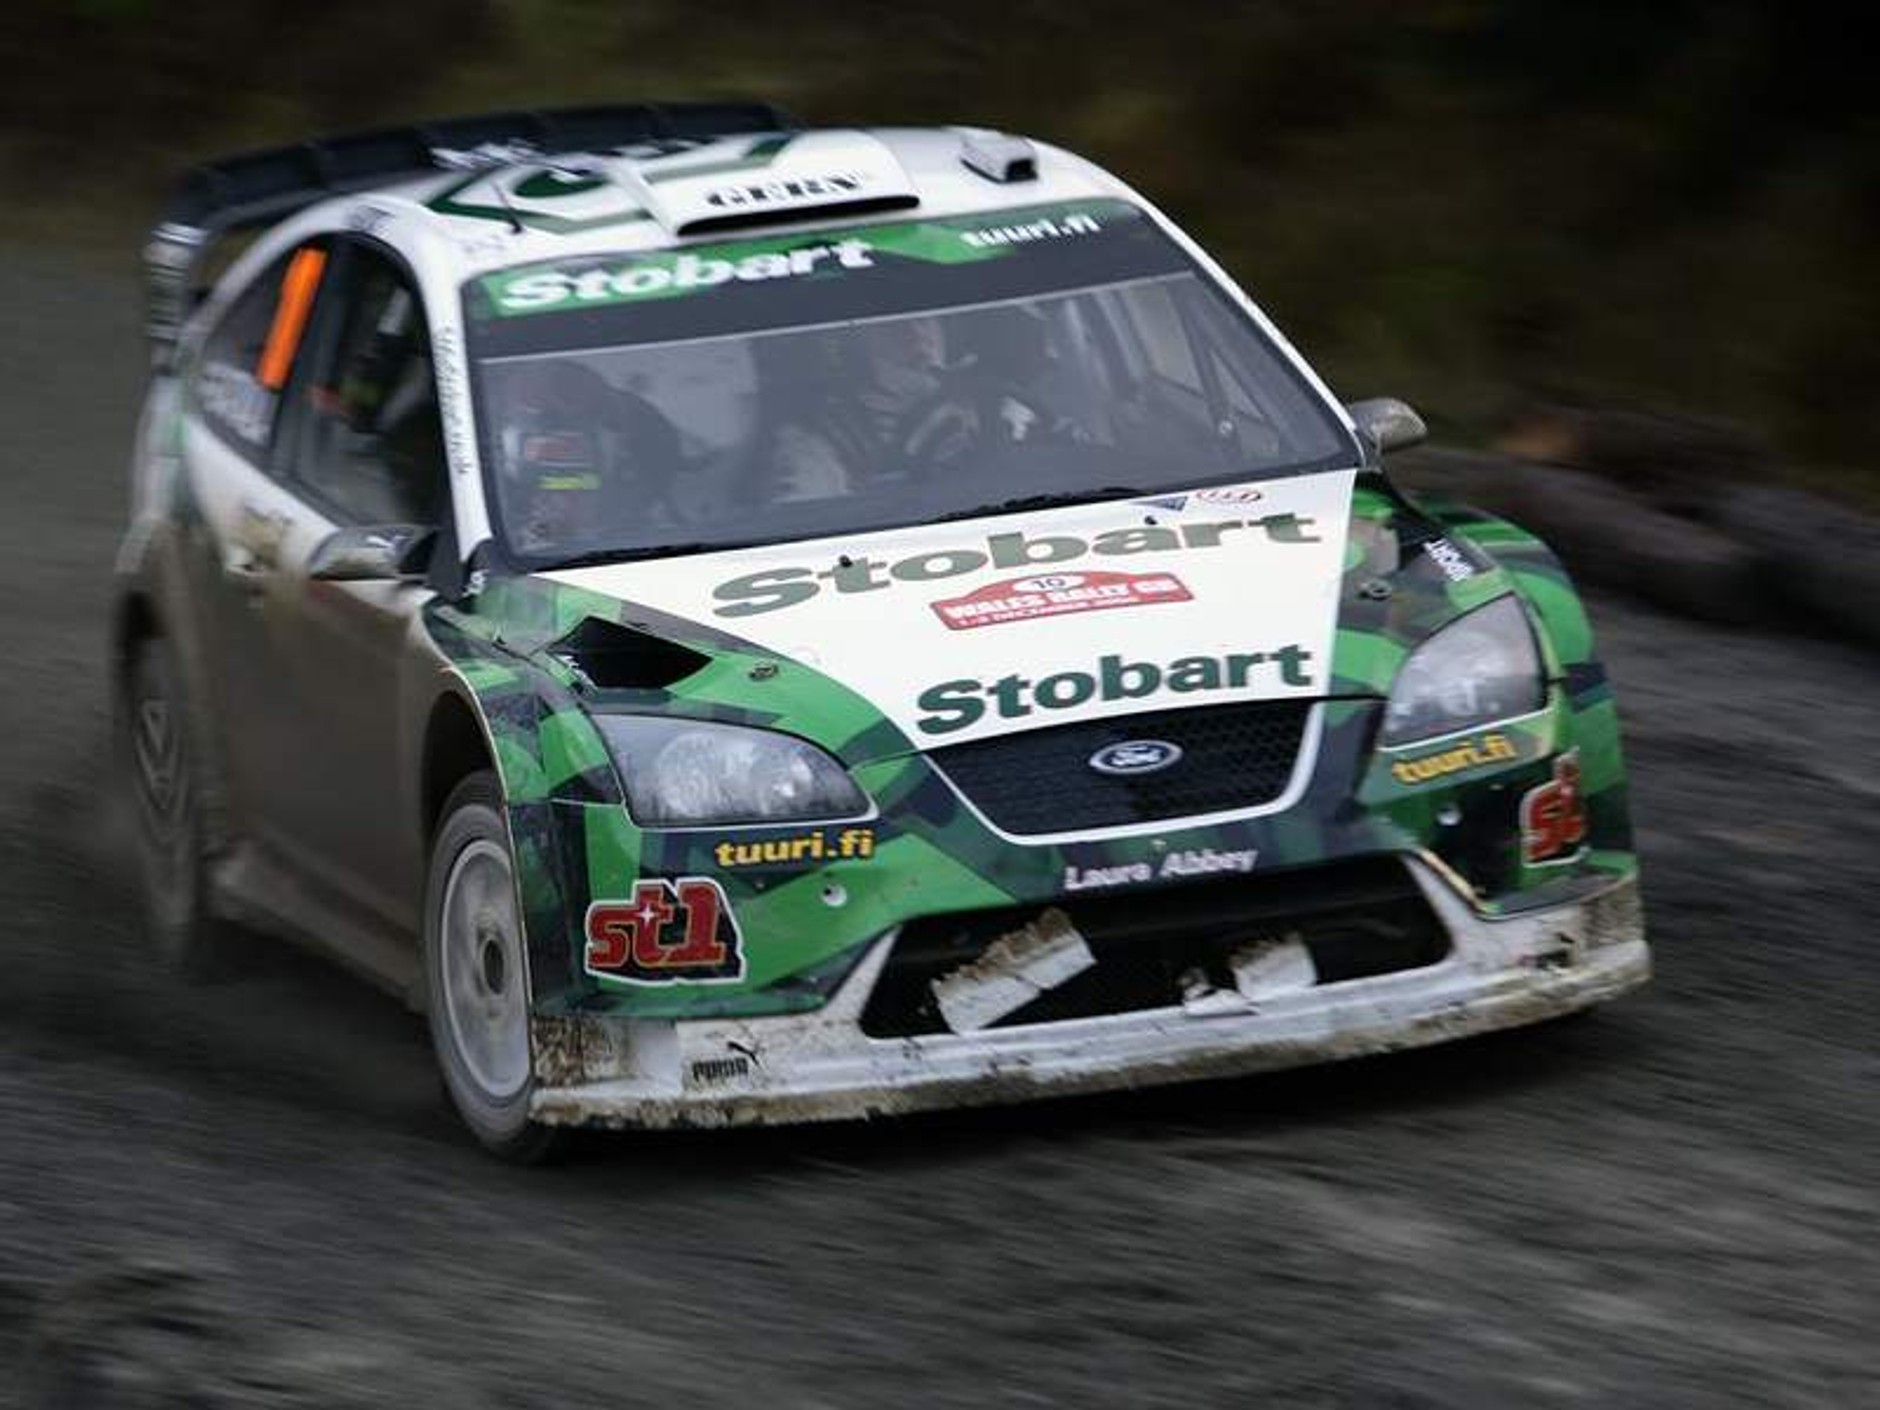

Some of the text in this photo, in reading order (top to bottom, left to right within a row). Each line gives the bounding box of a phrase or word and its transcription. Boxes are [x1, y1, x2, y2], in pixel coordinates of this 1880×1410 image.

[959, 213, 1101, 247] tuuri.fi
[501, 237, 874, 309] Stobart
[712, 512, 1321, 618] Stobart
[916, 642, 1313, 735] Stobart
[1391, 734, 1516, 785] tuuri.fi
[715, 829, 875, 867] tuuri.fi
[587, 880, 732, 971] st1
